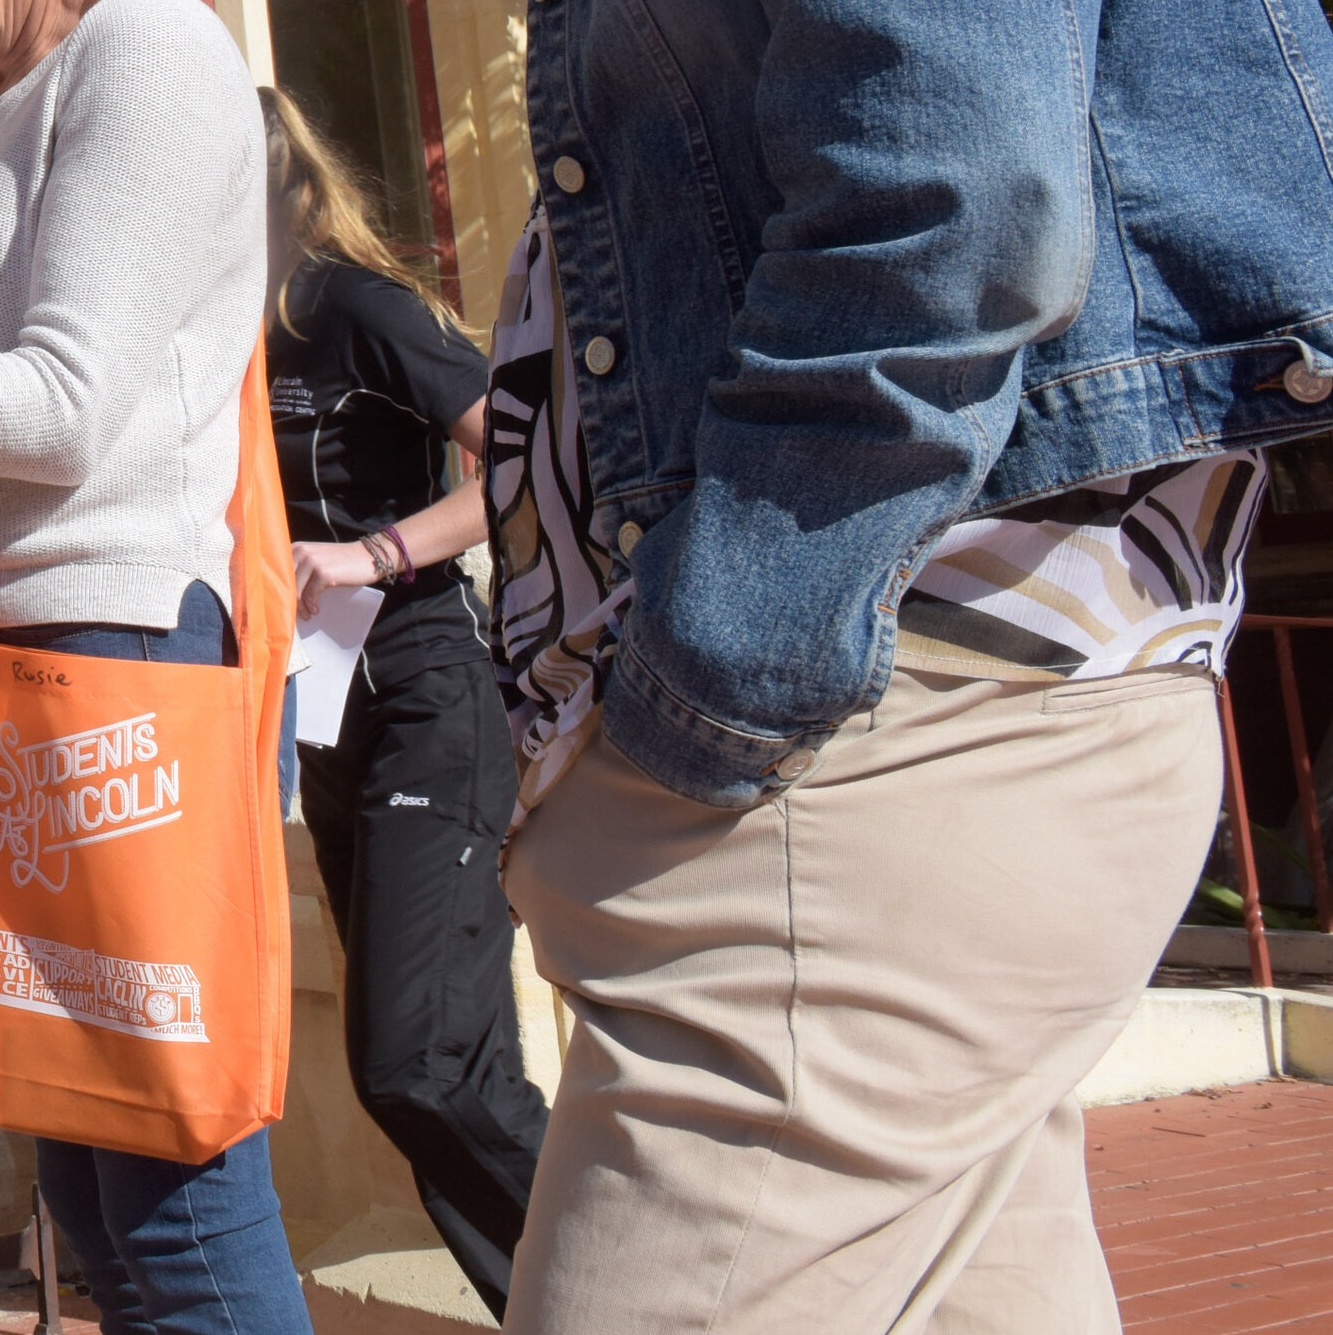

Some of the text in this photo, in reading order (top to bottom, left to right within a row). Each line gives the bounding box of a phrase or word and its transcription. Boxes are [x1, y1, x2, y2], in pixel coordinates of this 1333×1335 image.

[35, 959, 94, 986] SUPPORT
[94, 956, 149, 984] STUDENT
[150, 965, 200, 986] MEDIA
[33, 987, 94, 1015] GIVEAWAYS
[96, 975, 146, 1011] CACLIN
